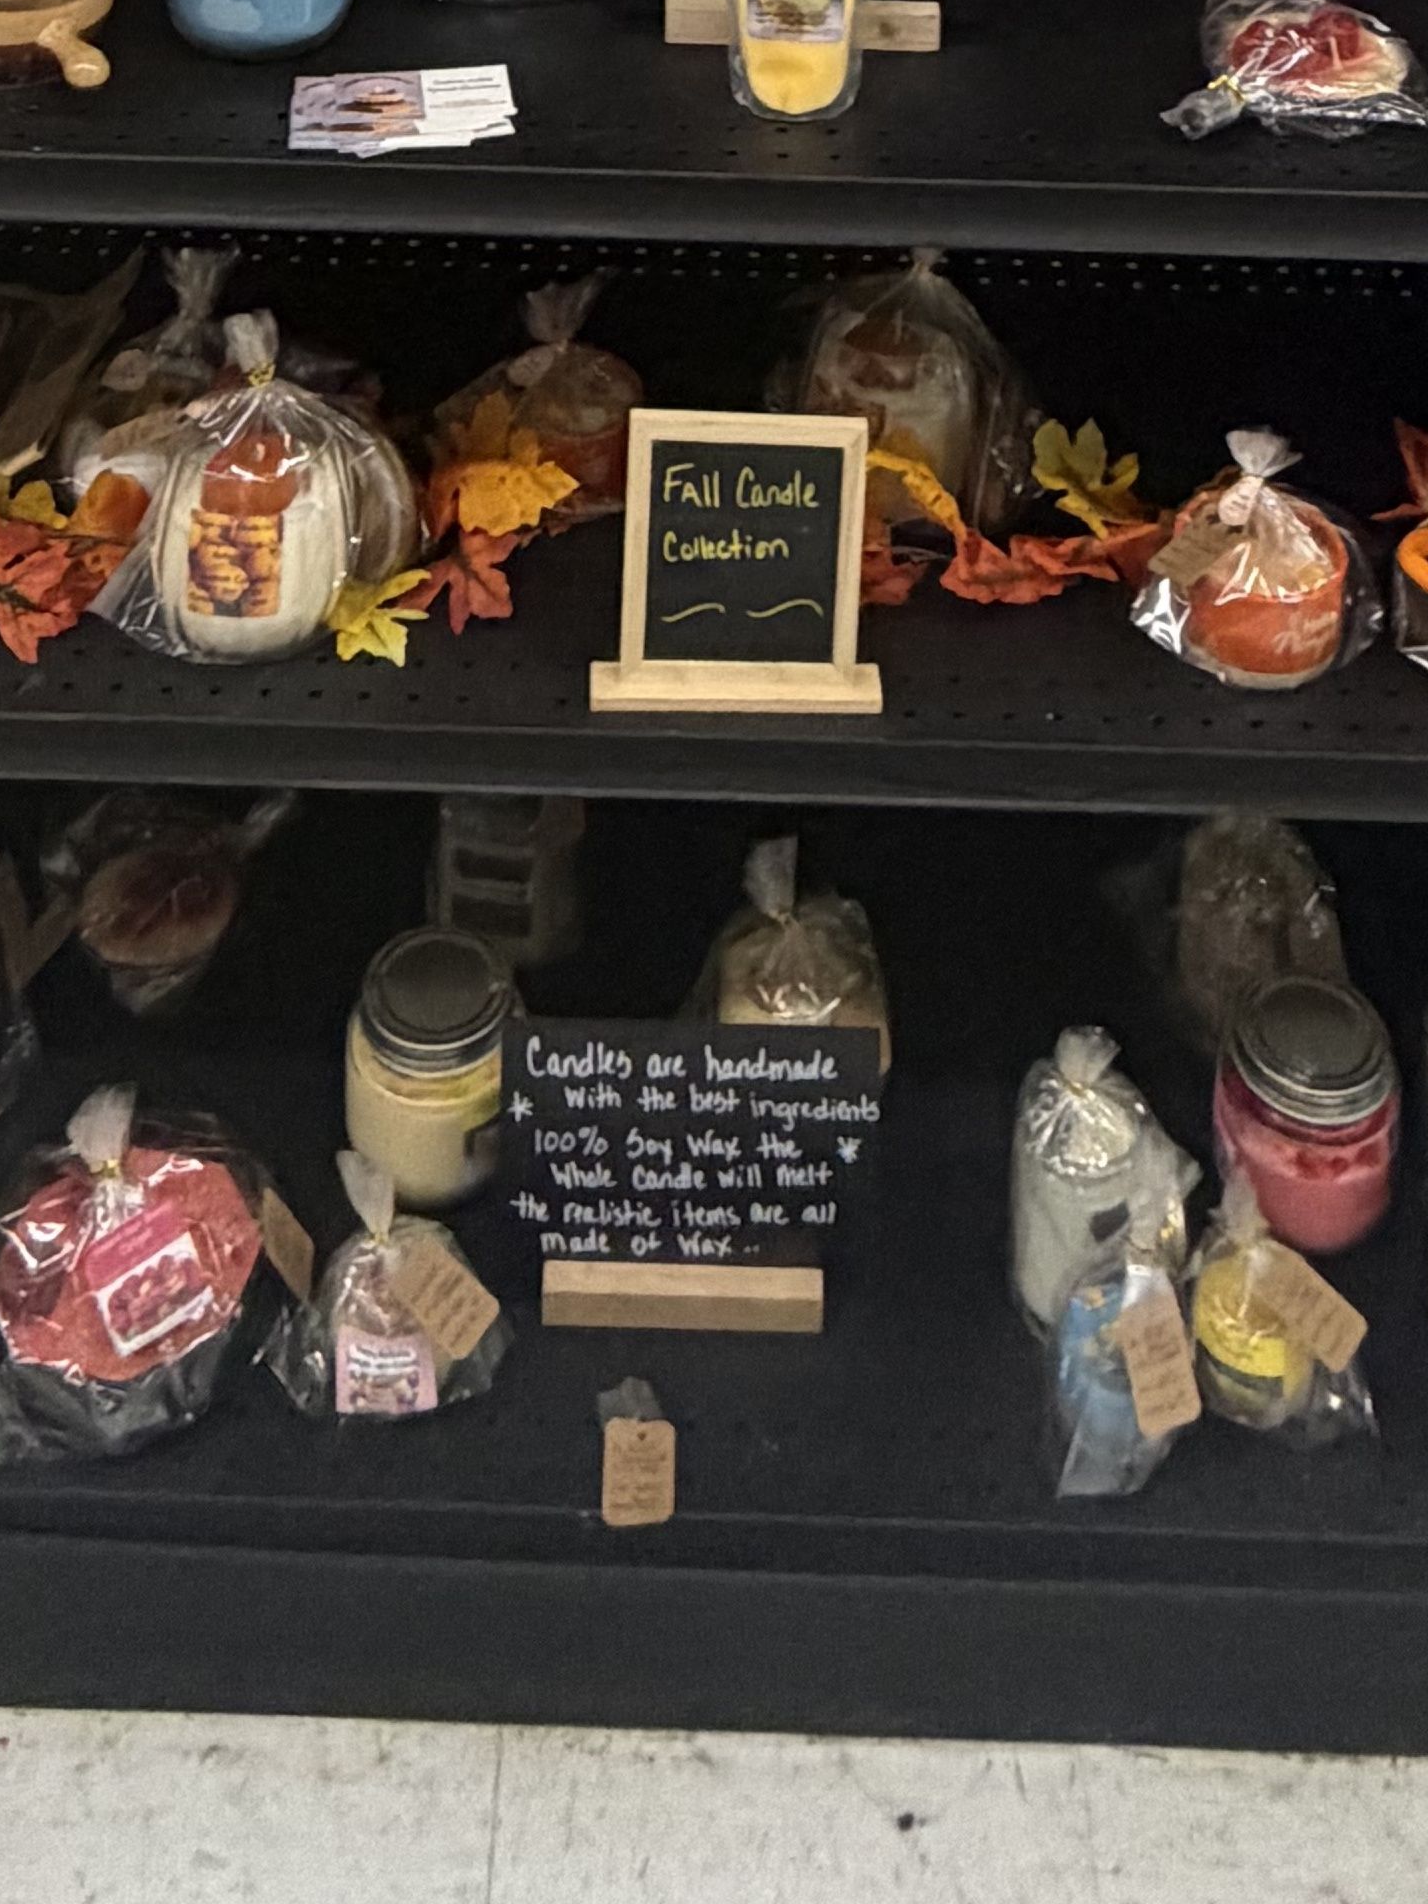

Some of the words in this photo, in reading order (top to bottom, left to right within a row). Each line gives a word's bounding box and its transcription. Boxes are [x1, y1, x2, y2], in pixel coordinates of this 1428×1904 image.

[736, 466, 819, 508] Candle
[663, 529, 789, 563] Collection
[527, 1036, 632, 1079] Candles
[647, 1054, 685, 1076] are
[705, 1044, 837, 1080] handmade
[637, 1087, 676, 1111] the
[690, 1085, 739, 1112] best
[751, 1094, 881, 1132] ingredients
[534, 1126, 608, 1152] 100%
[687, 1129, 741, 1159] Wax
[757, 1133, 802, 1158] the
[511, 1193, 550, 1223] the
[563, 1200, 661, 1228] realistic
[672, 1201, 739, 1227] items
[751, 1204, 789, 1223] are
[804, 1201, 836, 1224] all
[540, 1230, 609, 1254] made
[632, 1233, 661, 1256] of
